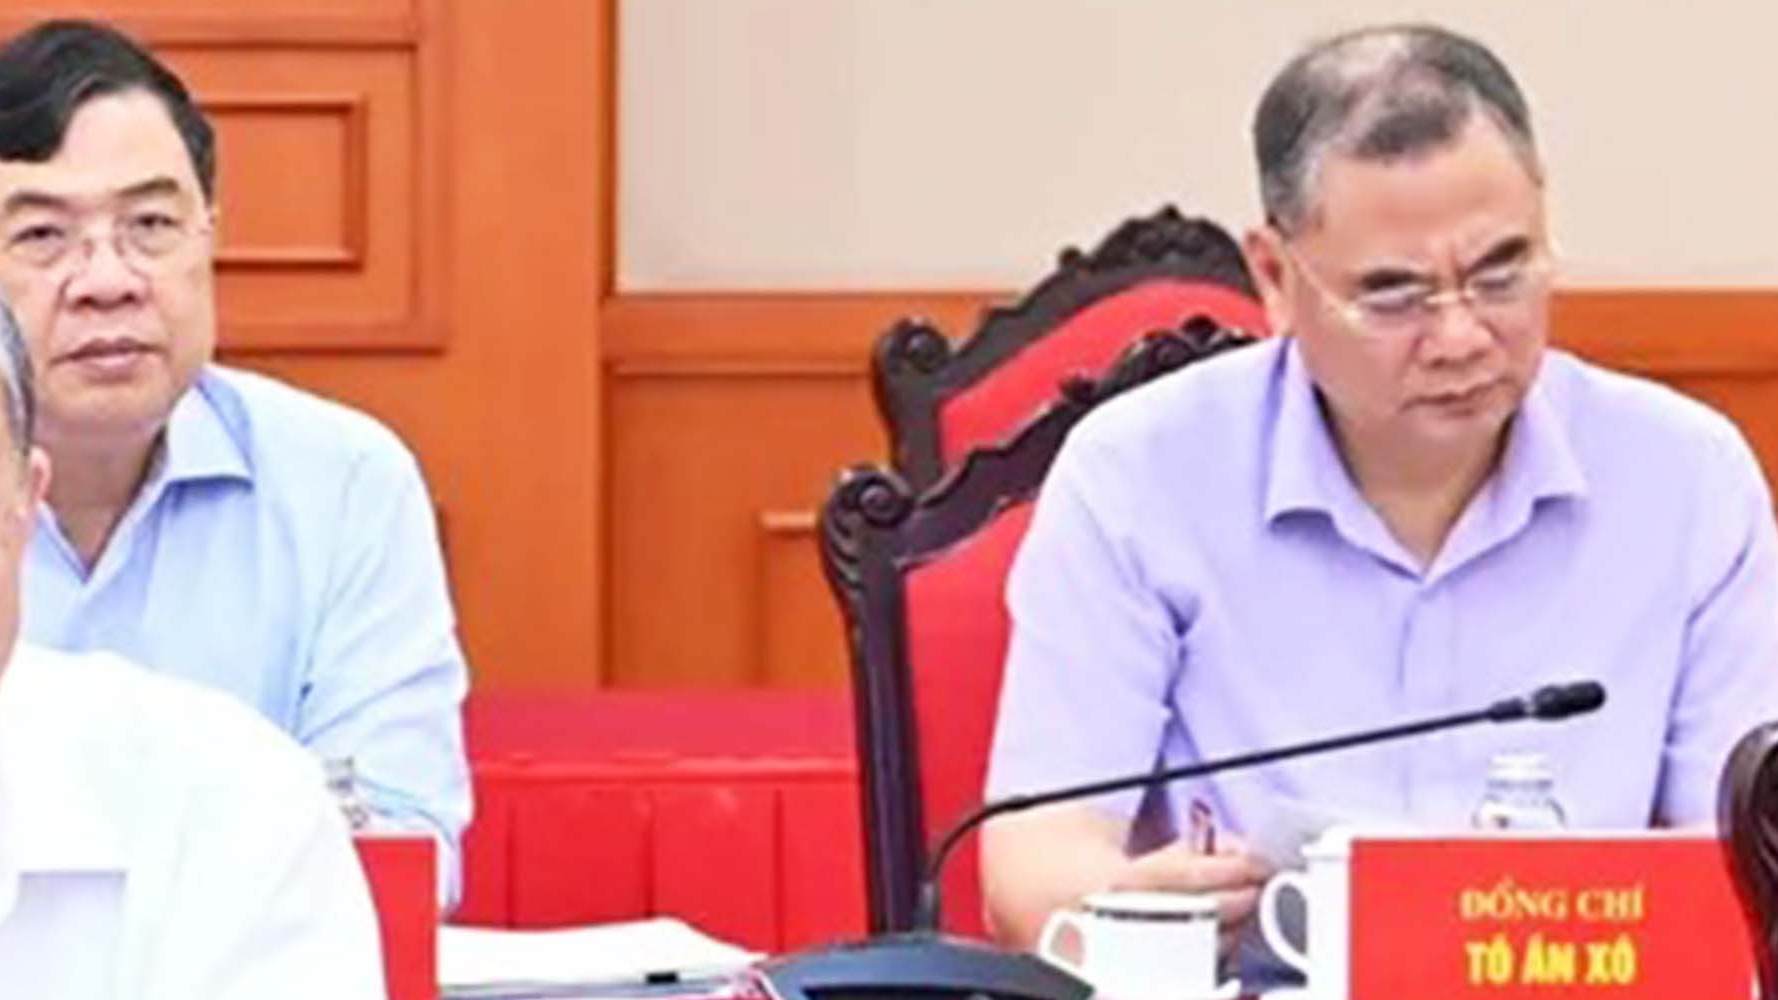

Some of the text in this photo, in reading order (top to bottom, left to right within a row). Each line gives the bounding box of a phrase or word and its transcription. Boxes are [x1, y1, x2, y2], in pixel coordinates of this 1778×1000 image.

[1576, 880, 1646, 920] CHÍ
[1465, 932, 1514, 985] TÔ
[1585, 932, 1636, 985] XÔ
